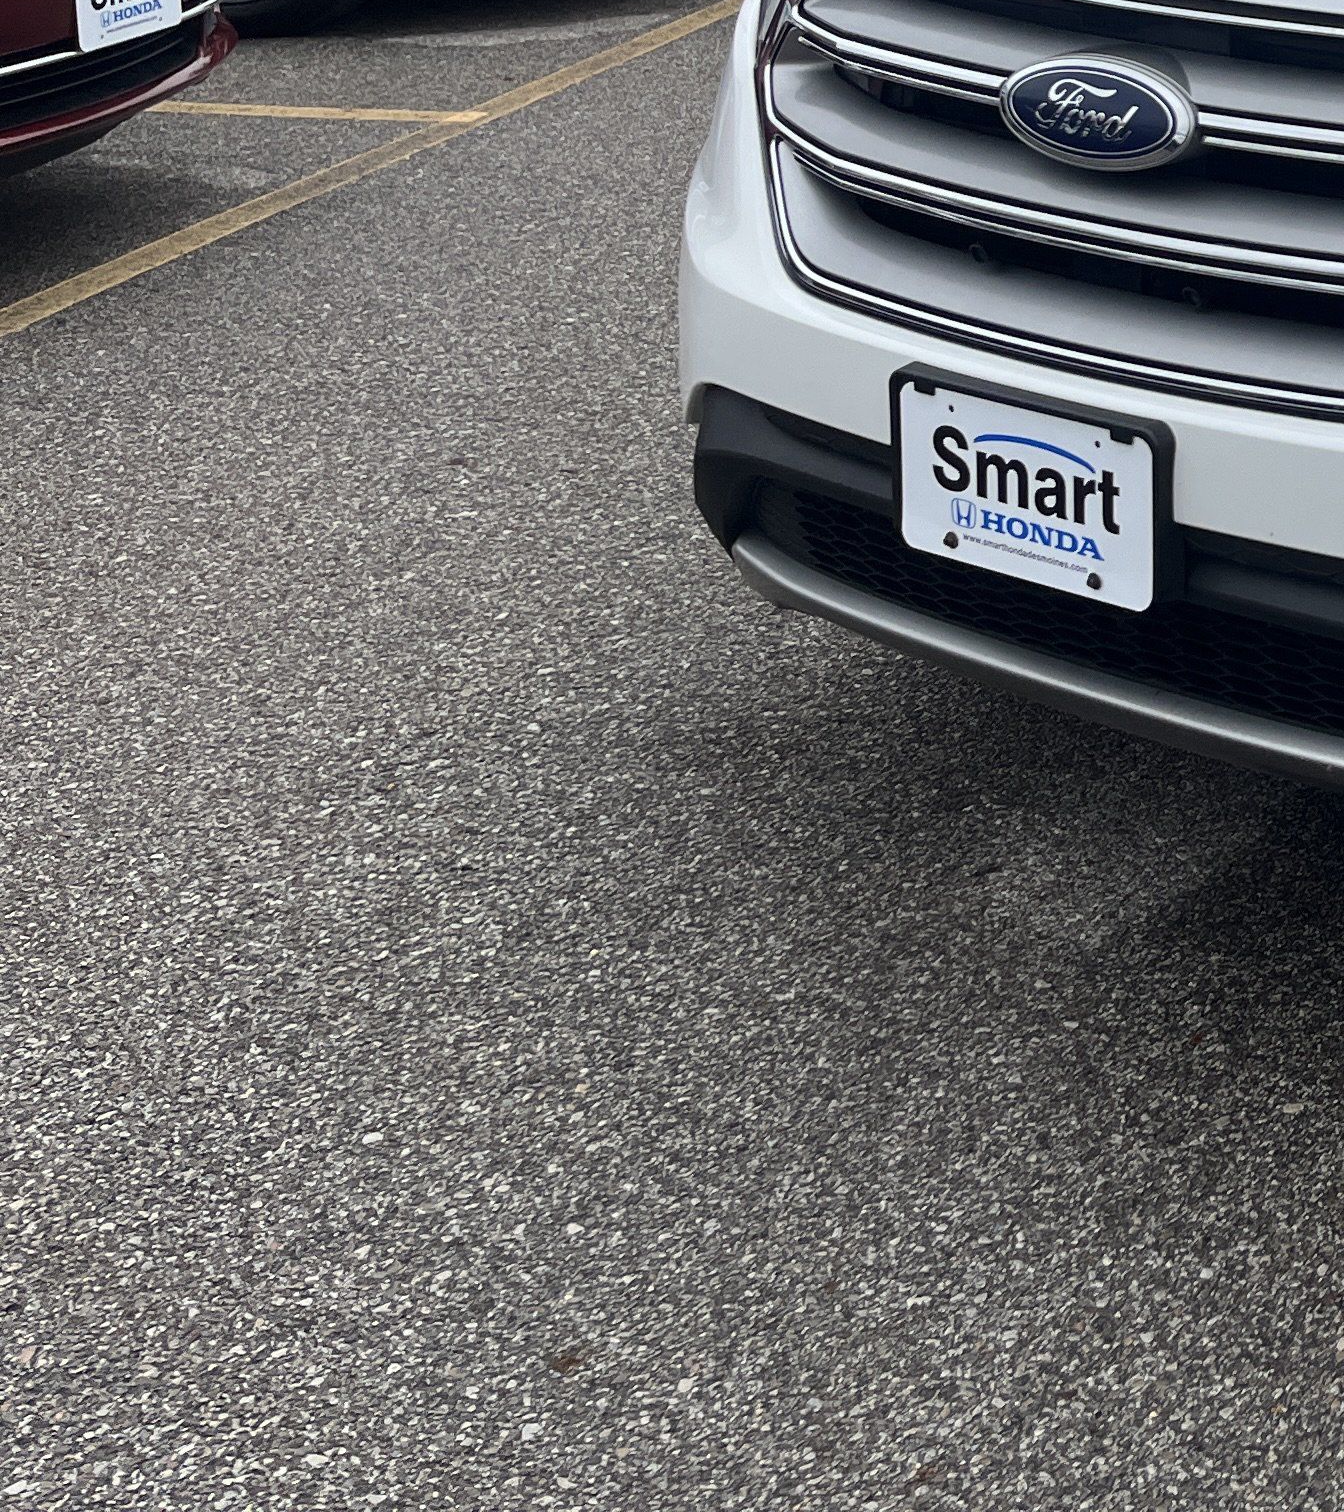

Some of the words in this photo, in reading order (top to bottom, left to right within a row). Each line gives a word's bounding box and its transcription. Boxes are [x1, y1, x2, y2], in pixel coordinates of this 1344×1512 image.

[113, 0, 162, 23] HONDA
[1034, 79, 1139, 142] Ford
[932, 424, 1120, 535] Smart
[981, 508, 1104, 562] HONDA
